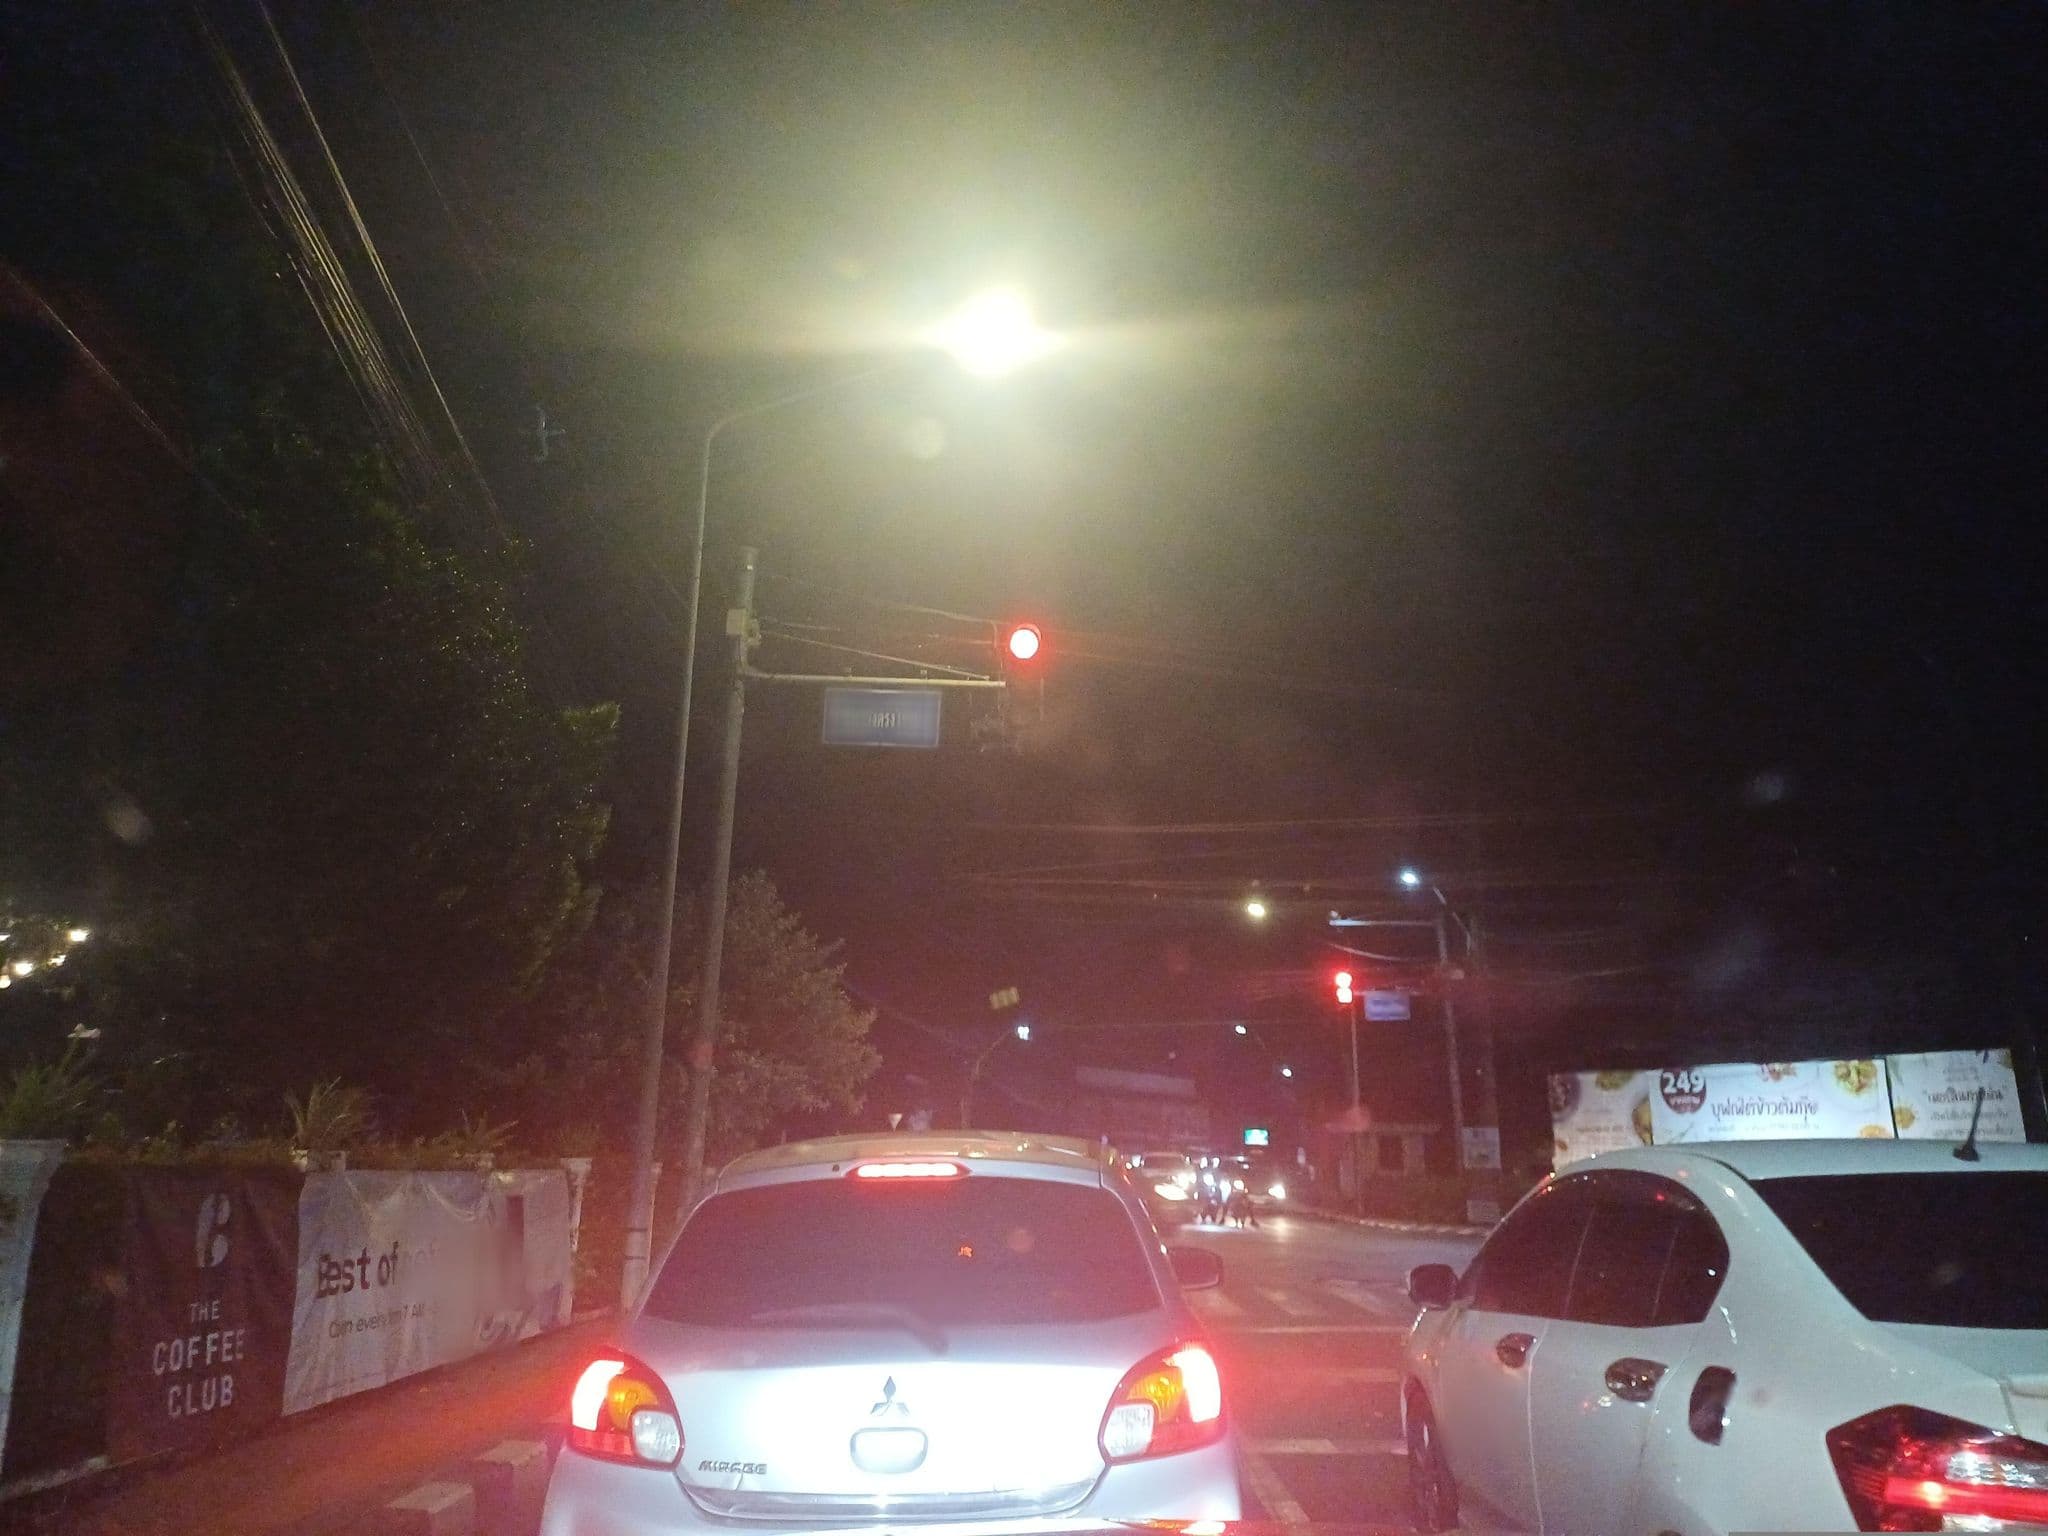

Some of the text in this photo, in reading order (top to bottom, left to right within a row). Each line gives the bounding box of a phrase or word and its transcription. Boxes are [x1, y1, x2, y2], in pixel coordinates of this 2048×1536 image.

[1662, 1070, 1706, 1094] 249
[190, 1299, 221, 1322] THE
[152, 1329, 246, 1376] COFFEE
[167, 1375, 234, 1418] CLUB
[698, 1459, 768, 1475] MIRAGE
